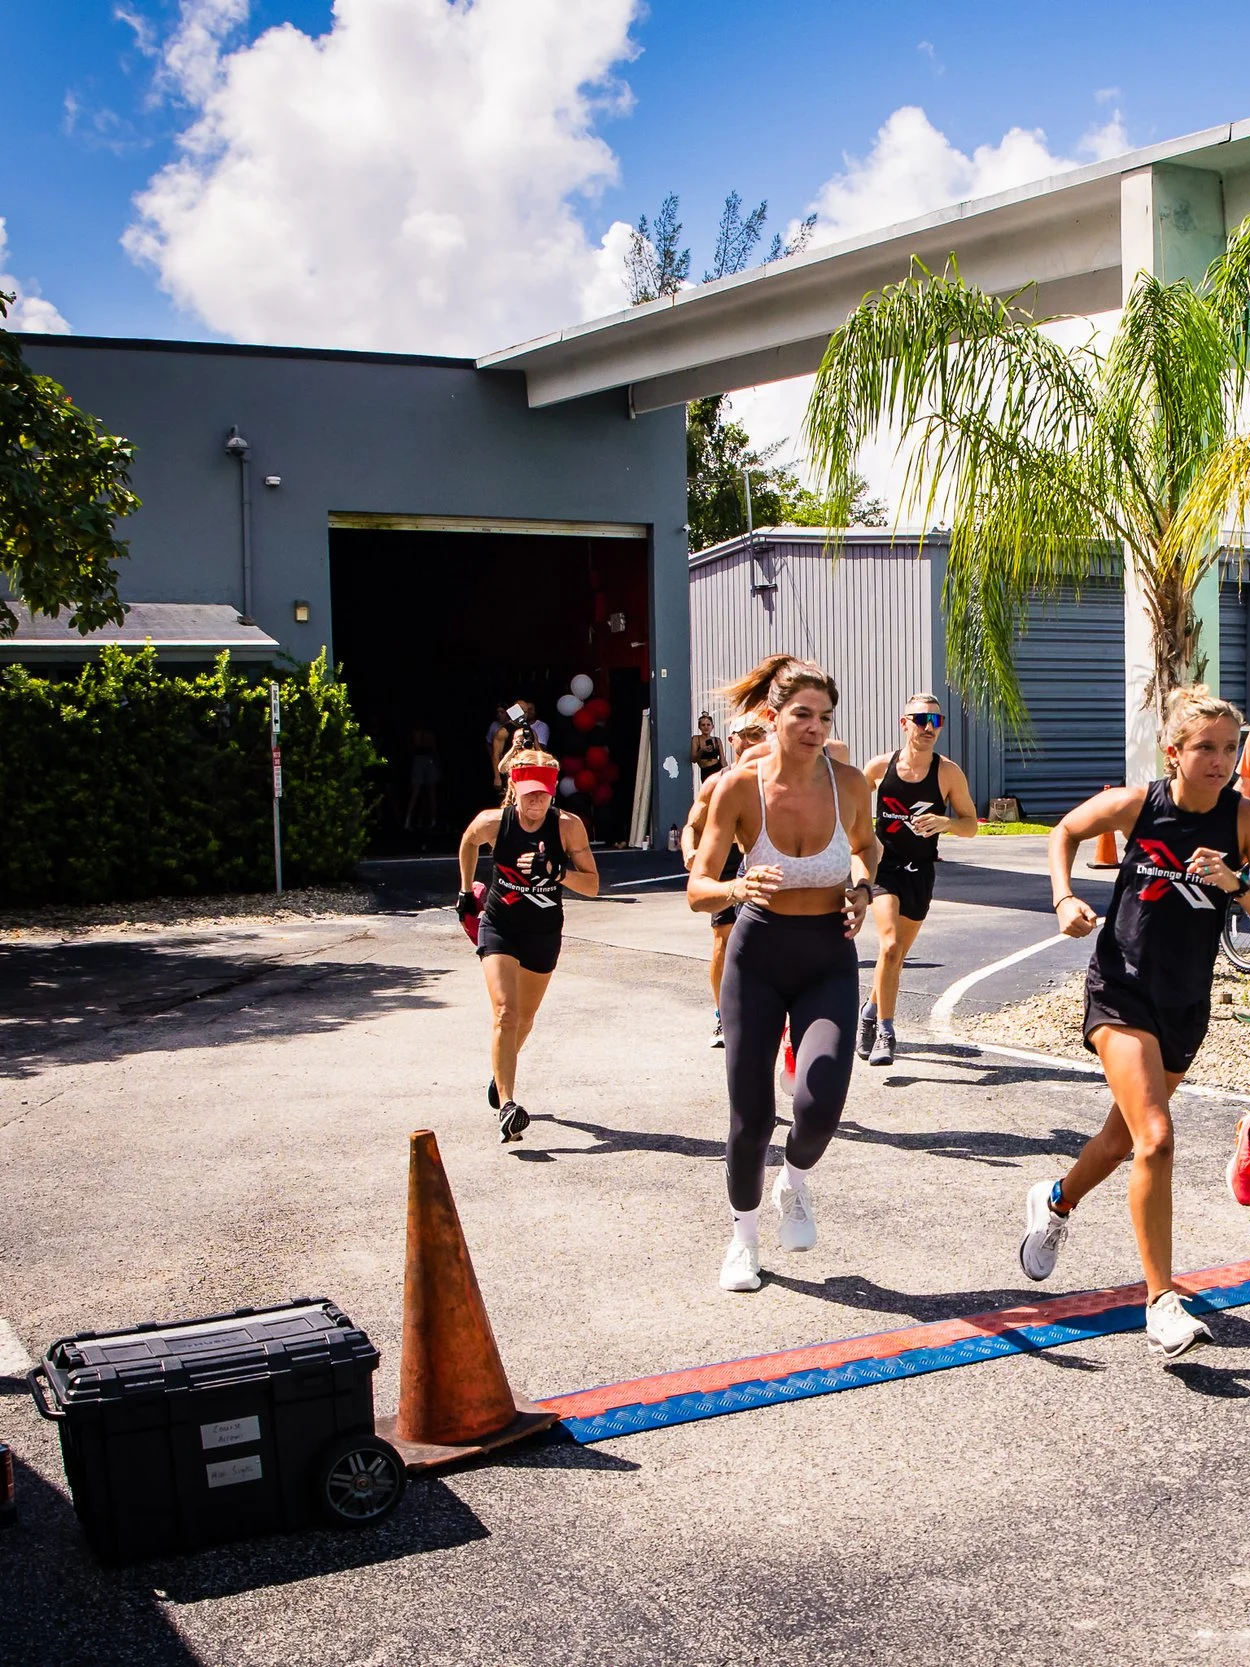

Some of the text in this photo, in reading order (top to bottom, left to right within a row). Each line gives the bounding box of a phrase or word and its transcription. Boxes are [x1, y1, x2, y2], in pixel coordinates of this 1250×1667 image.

[882, 811, 909, 821] Challenge
[1136, 864, 1217, 887] Challenge Fitn
[498, 878, 557, 893] Challenge Fitness
